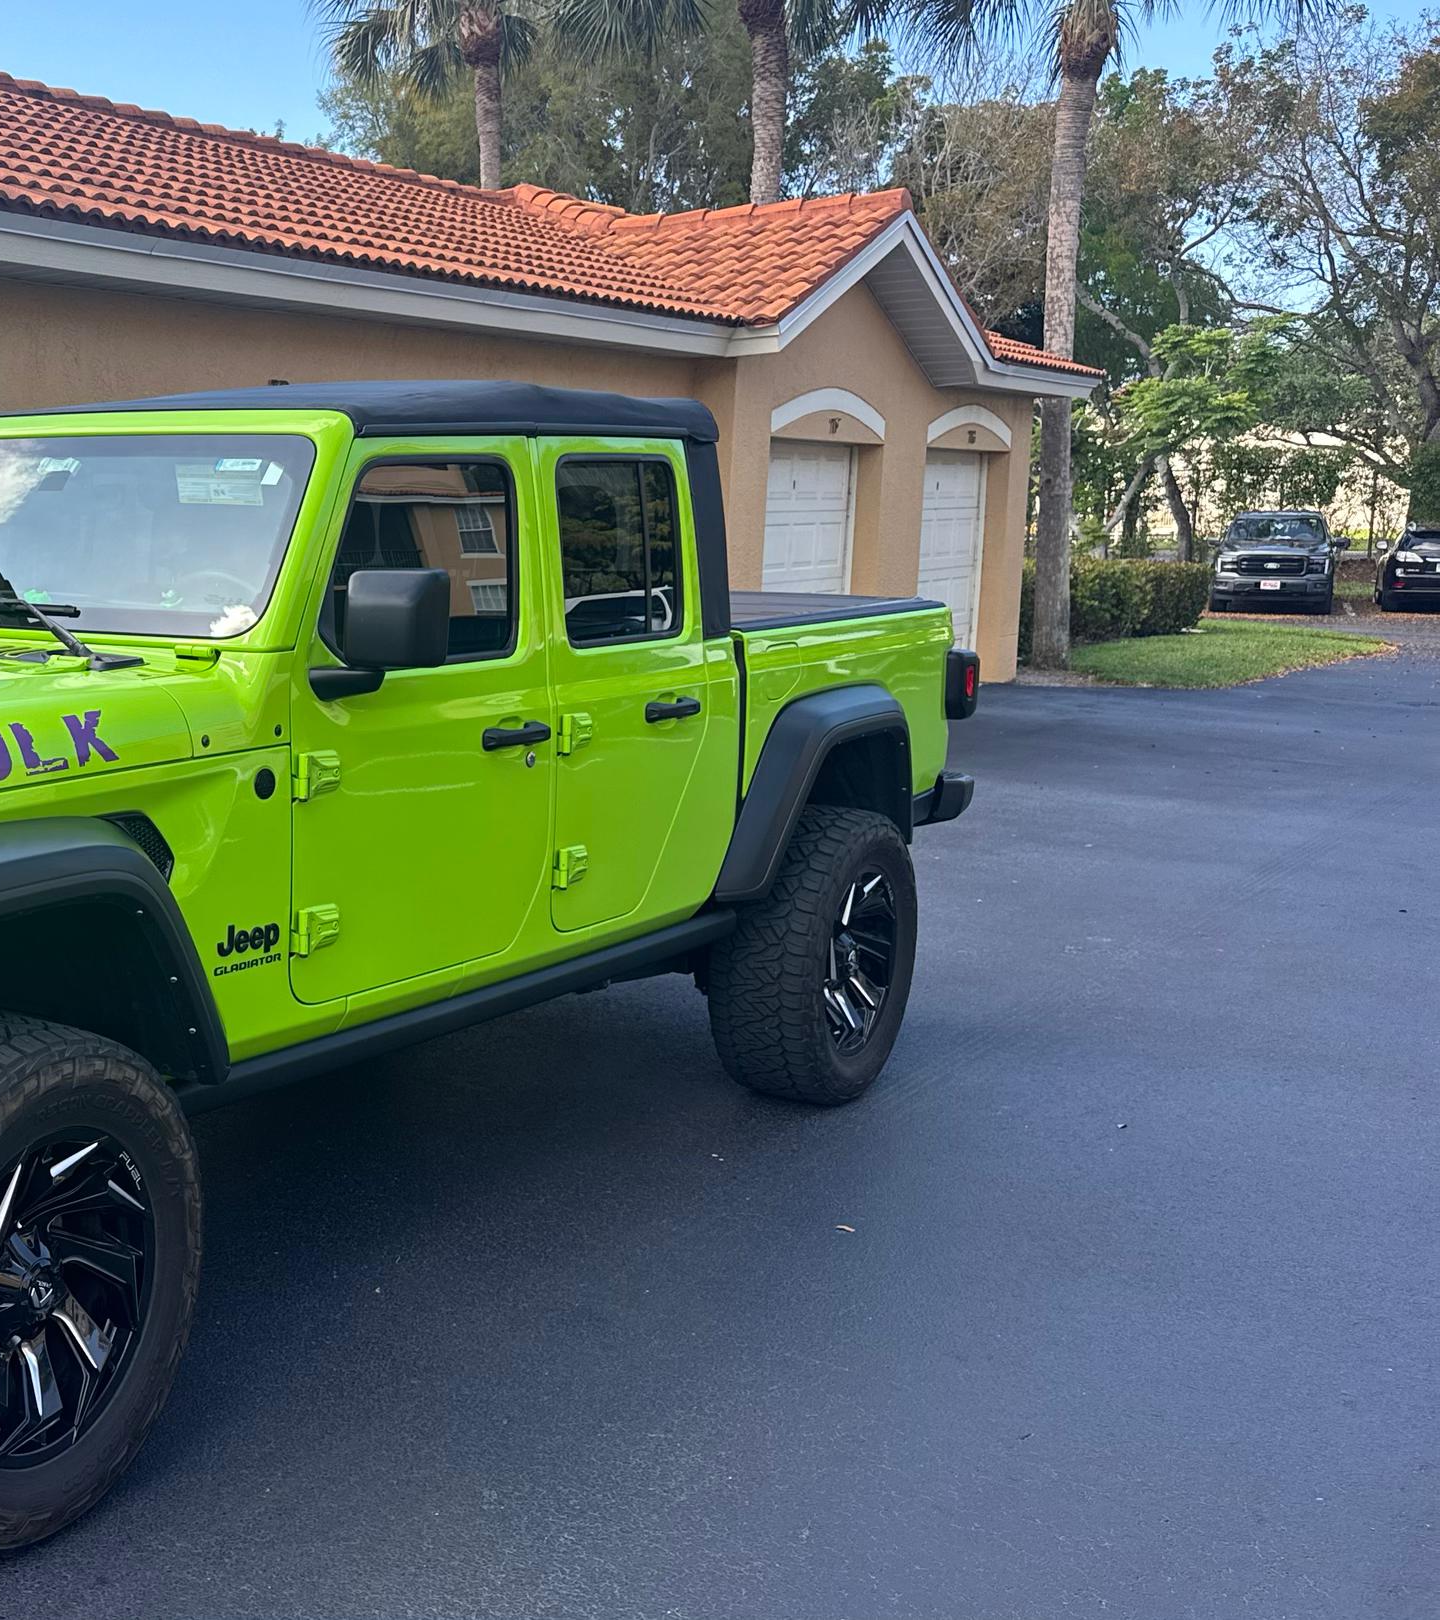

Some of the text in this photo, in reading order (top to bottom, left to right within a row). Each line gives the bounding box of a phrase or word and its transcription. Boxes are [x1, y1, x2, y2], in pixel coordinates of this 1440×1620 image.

[216, 922, 280, 957] Jeep
[213, 952, 282, 977] GLADIATOR
[118, 1150, 142, 1191] FUEL
